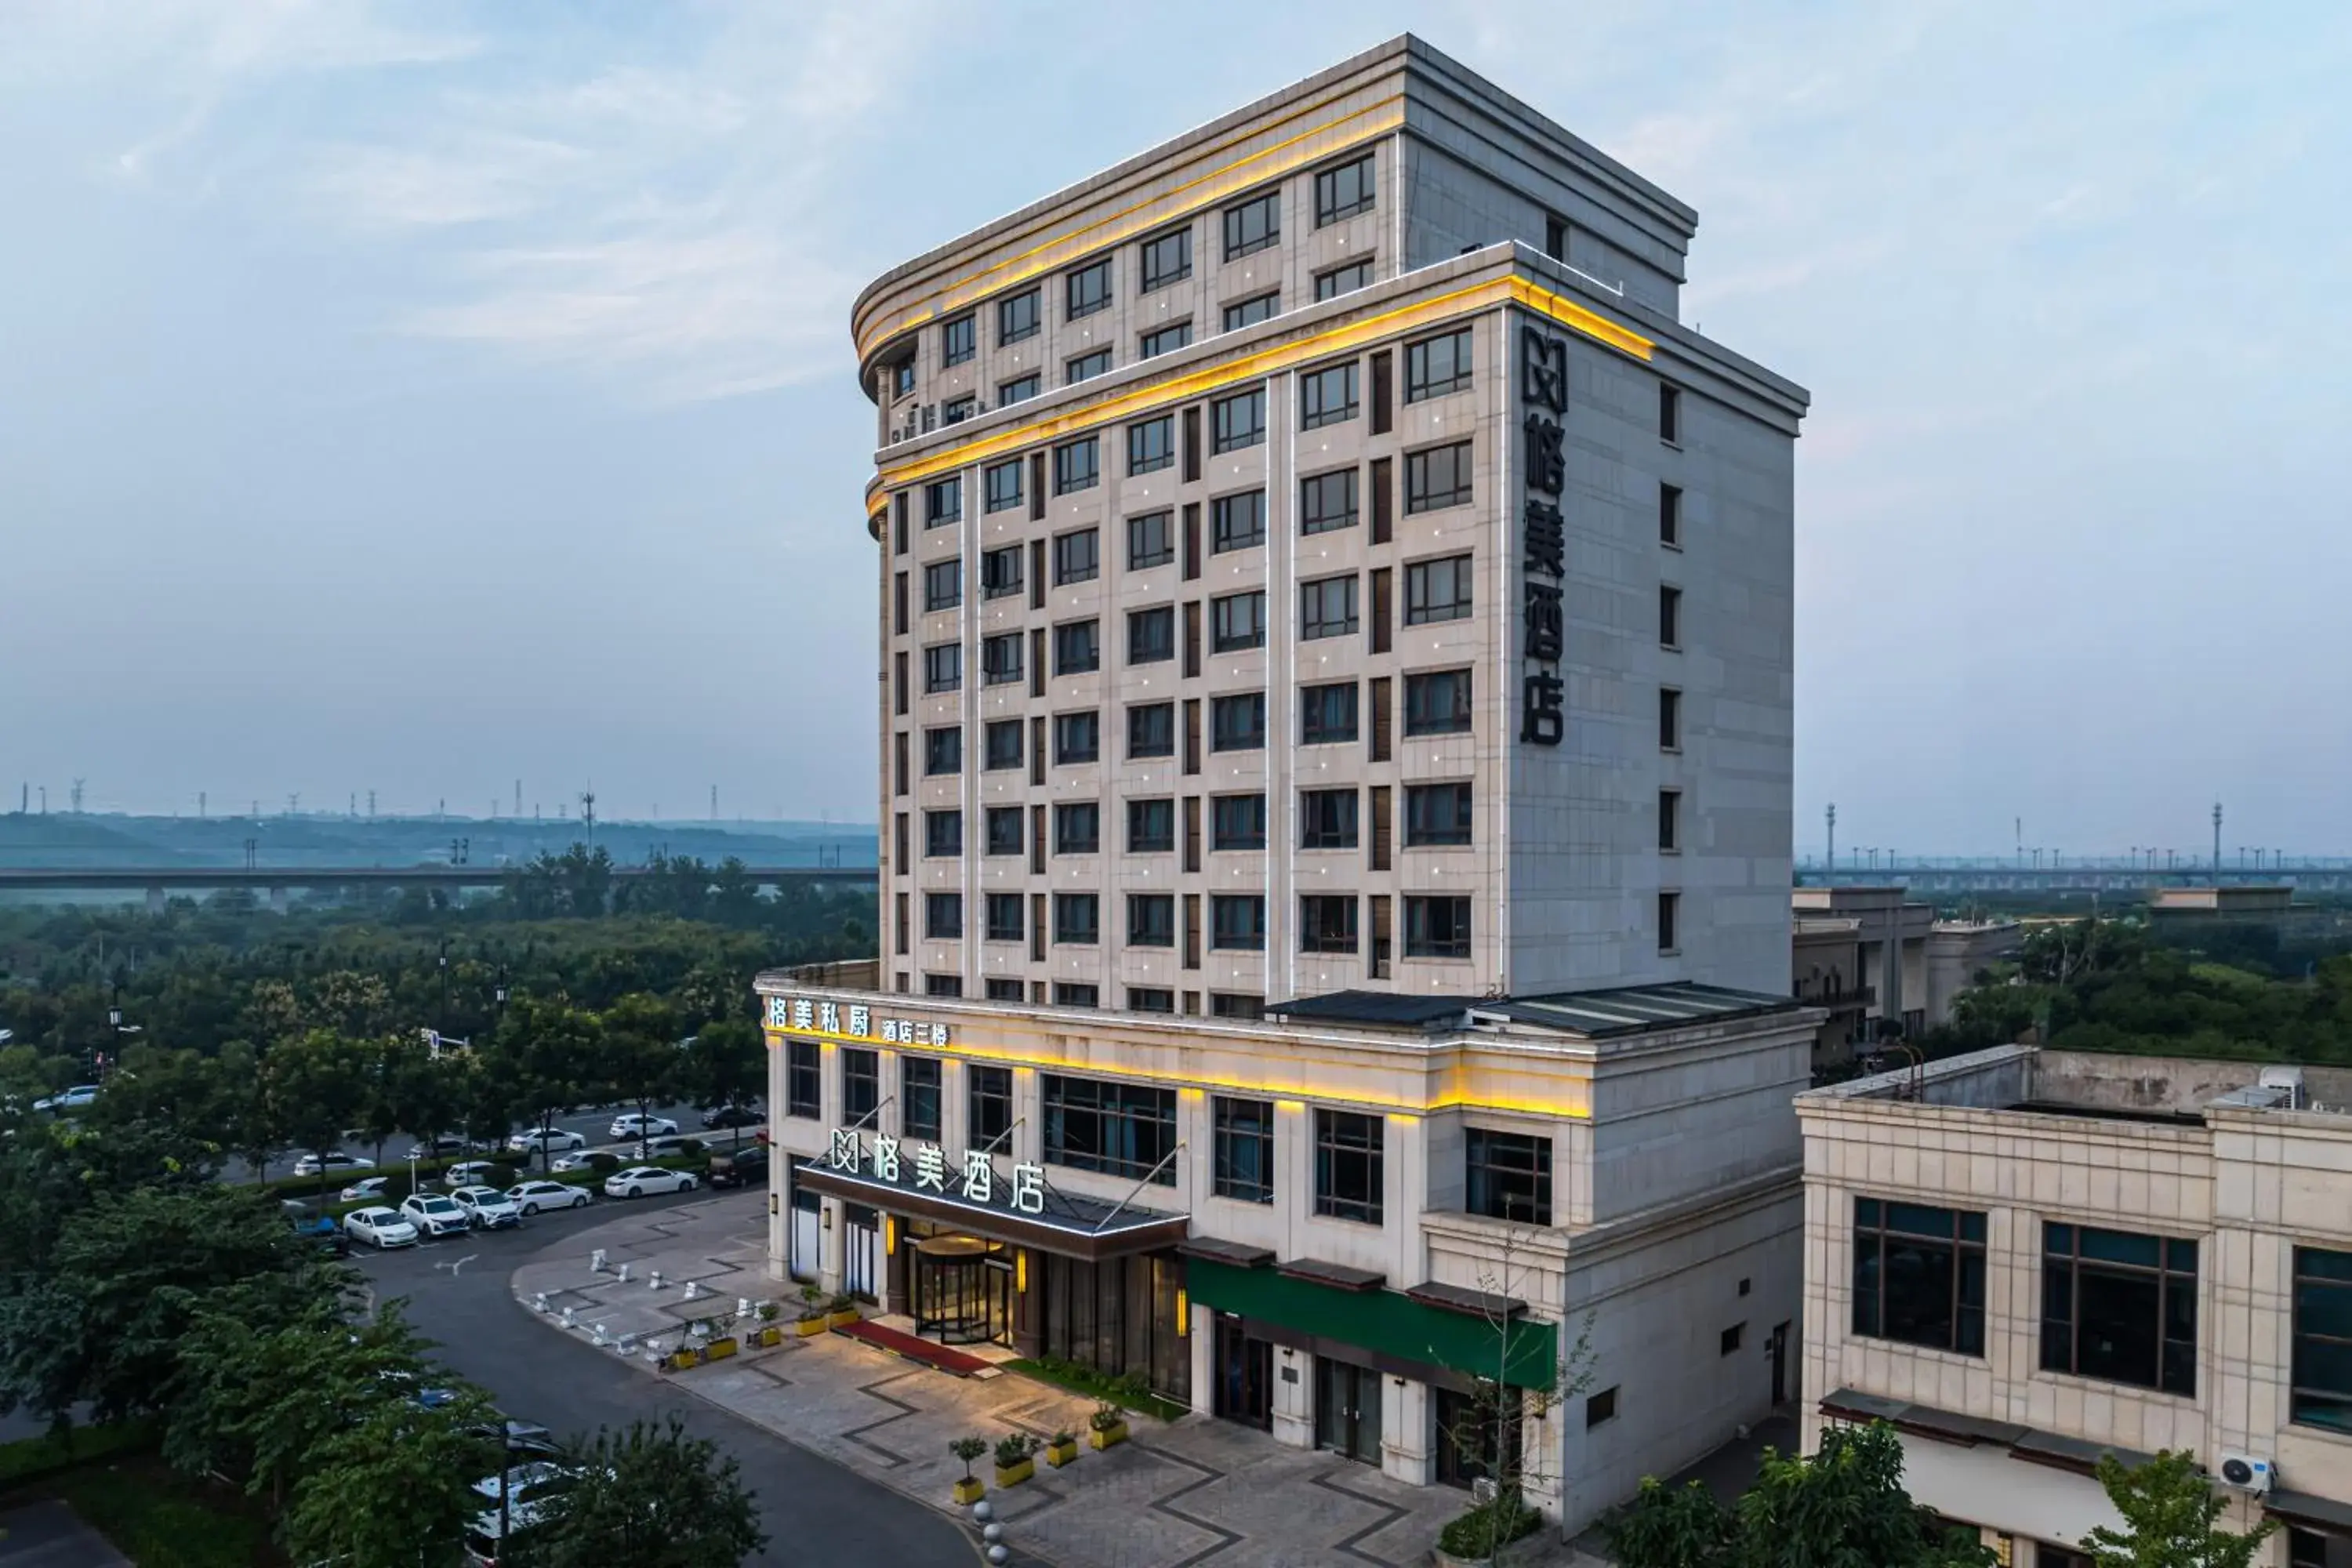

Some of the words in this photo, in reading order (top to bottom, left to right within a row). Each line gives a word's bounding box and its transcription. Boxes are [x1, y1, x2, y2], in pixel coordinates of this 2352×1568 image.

[1521, 325, 1568, 745] 风格美酒店
[769, 996, 869, 1037] 格美私厨
[882, 1019, 947, 1047] 酒店三楼
[832, 1128, 1044, 1214] 风格美酒店
